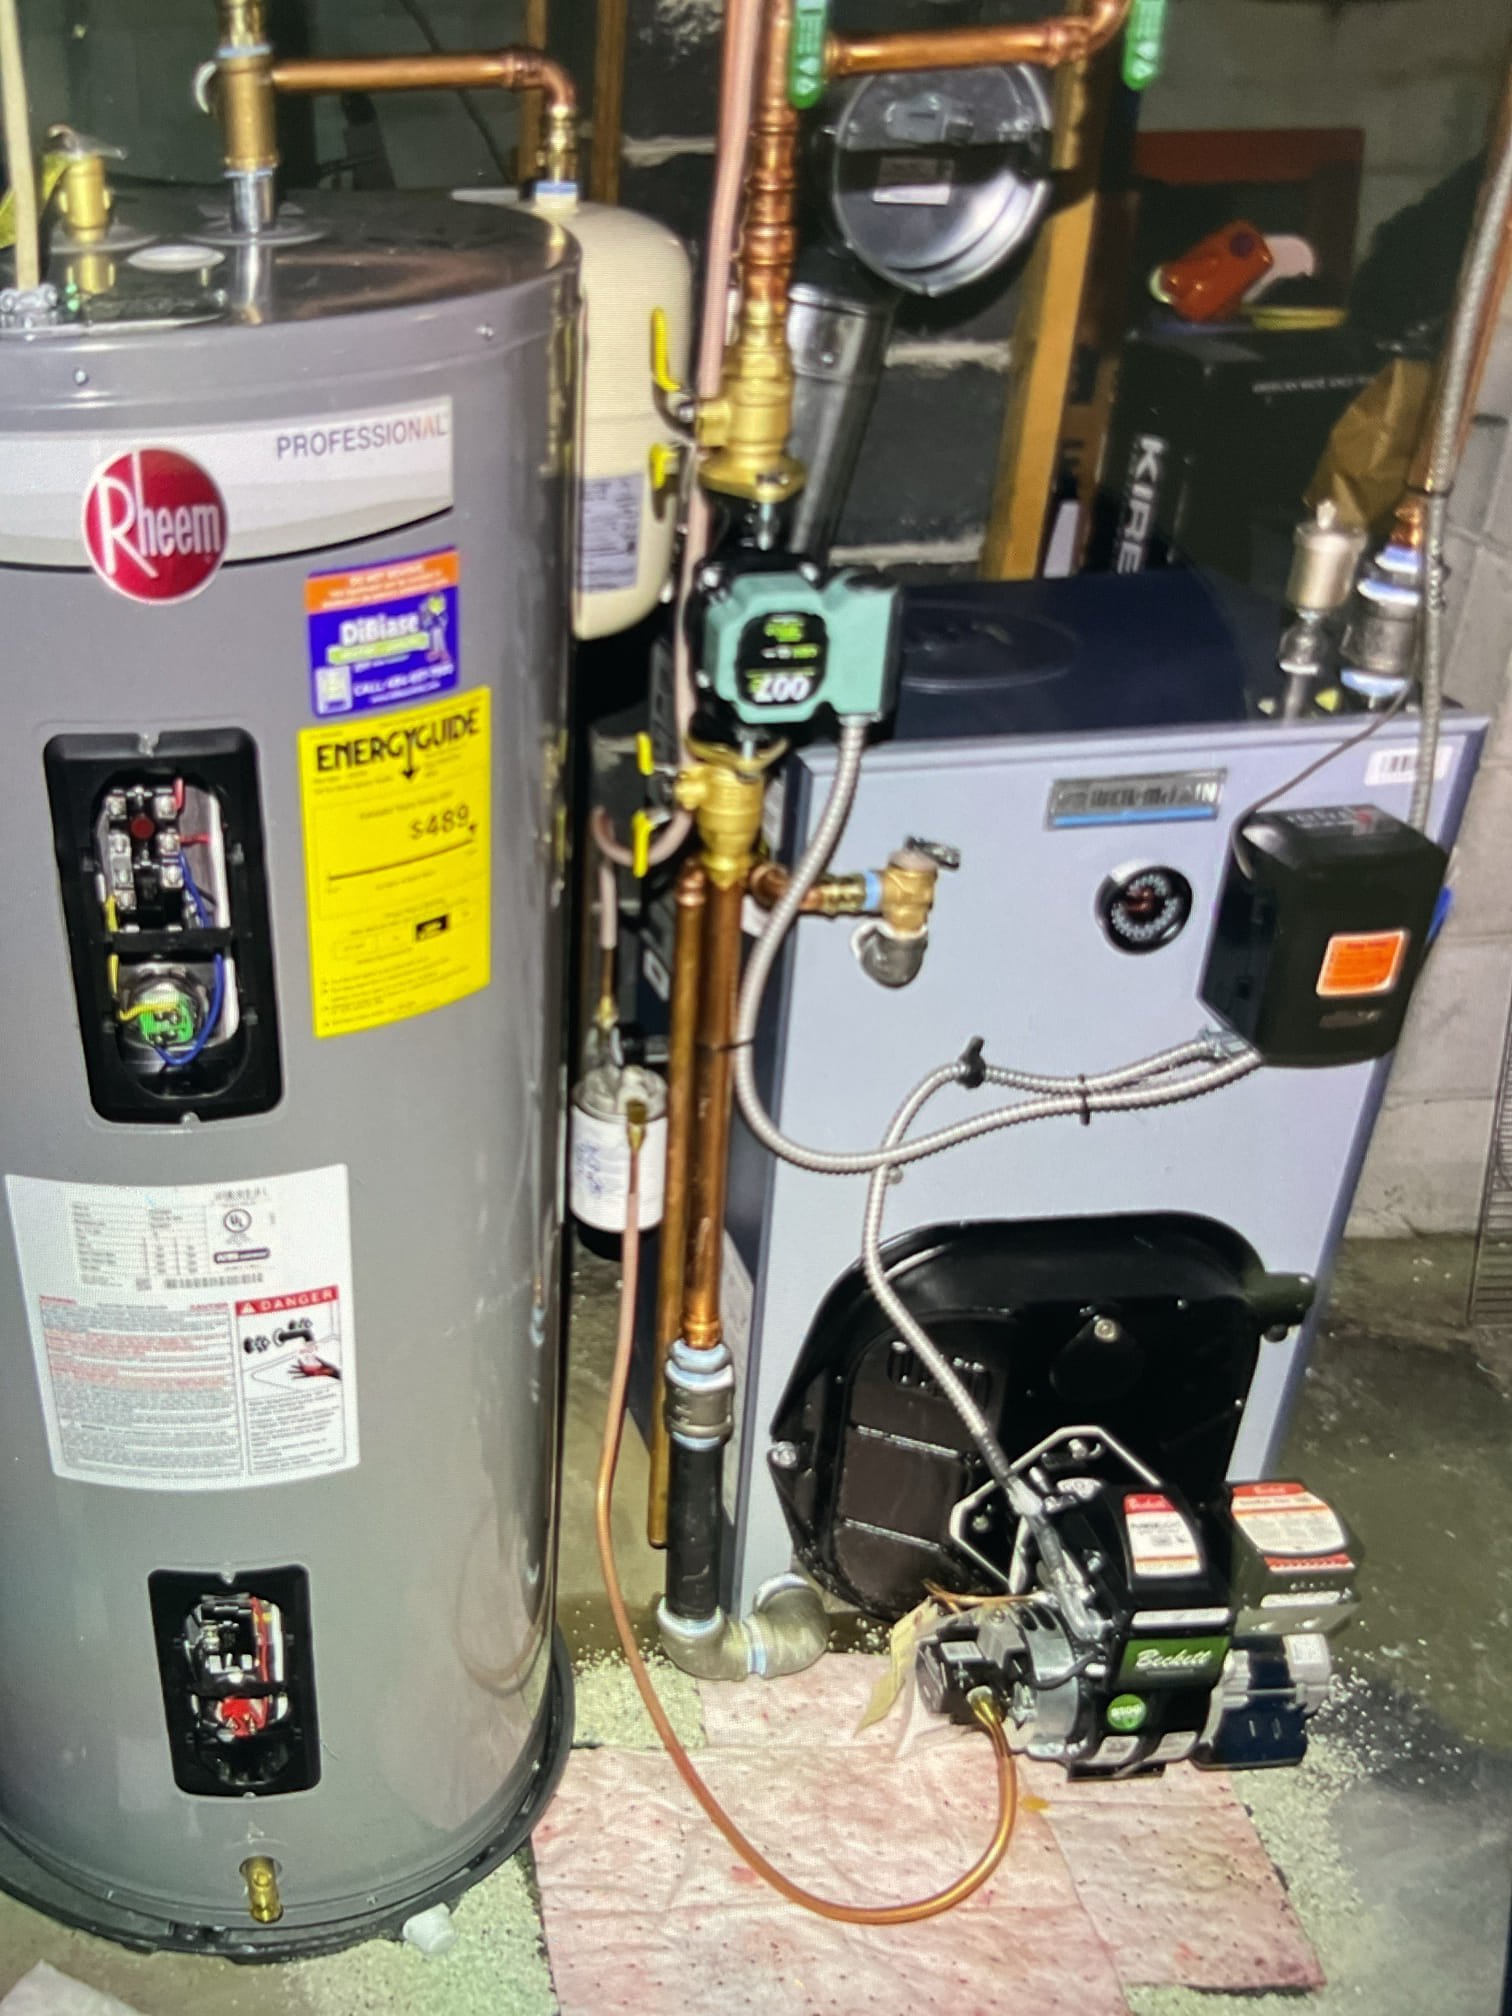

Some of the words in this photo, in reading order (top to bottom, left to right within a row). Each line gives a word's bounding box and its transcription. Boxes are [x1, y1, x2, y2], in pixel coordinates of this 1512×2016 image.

[276, 414, 448, 460] PROFESSIONAL
[94, 450, 221, 579] Rheem
[316, 708, 480, 774] ENERGYGUIDE
[410, 804, 470, 840] $489
[260, 1289, 333, 1310] DANGER
[1135, 1648, 1213, 1670] Beckett
